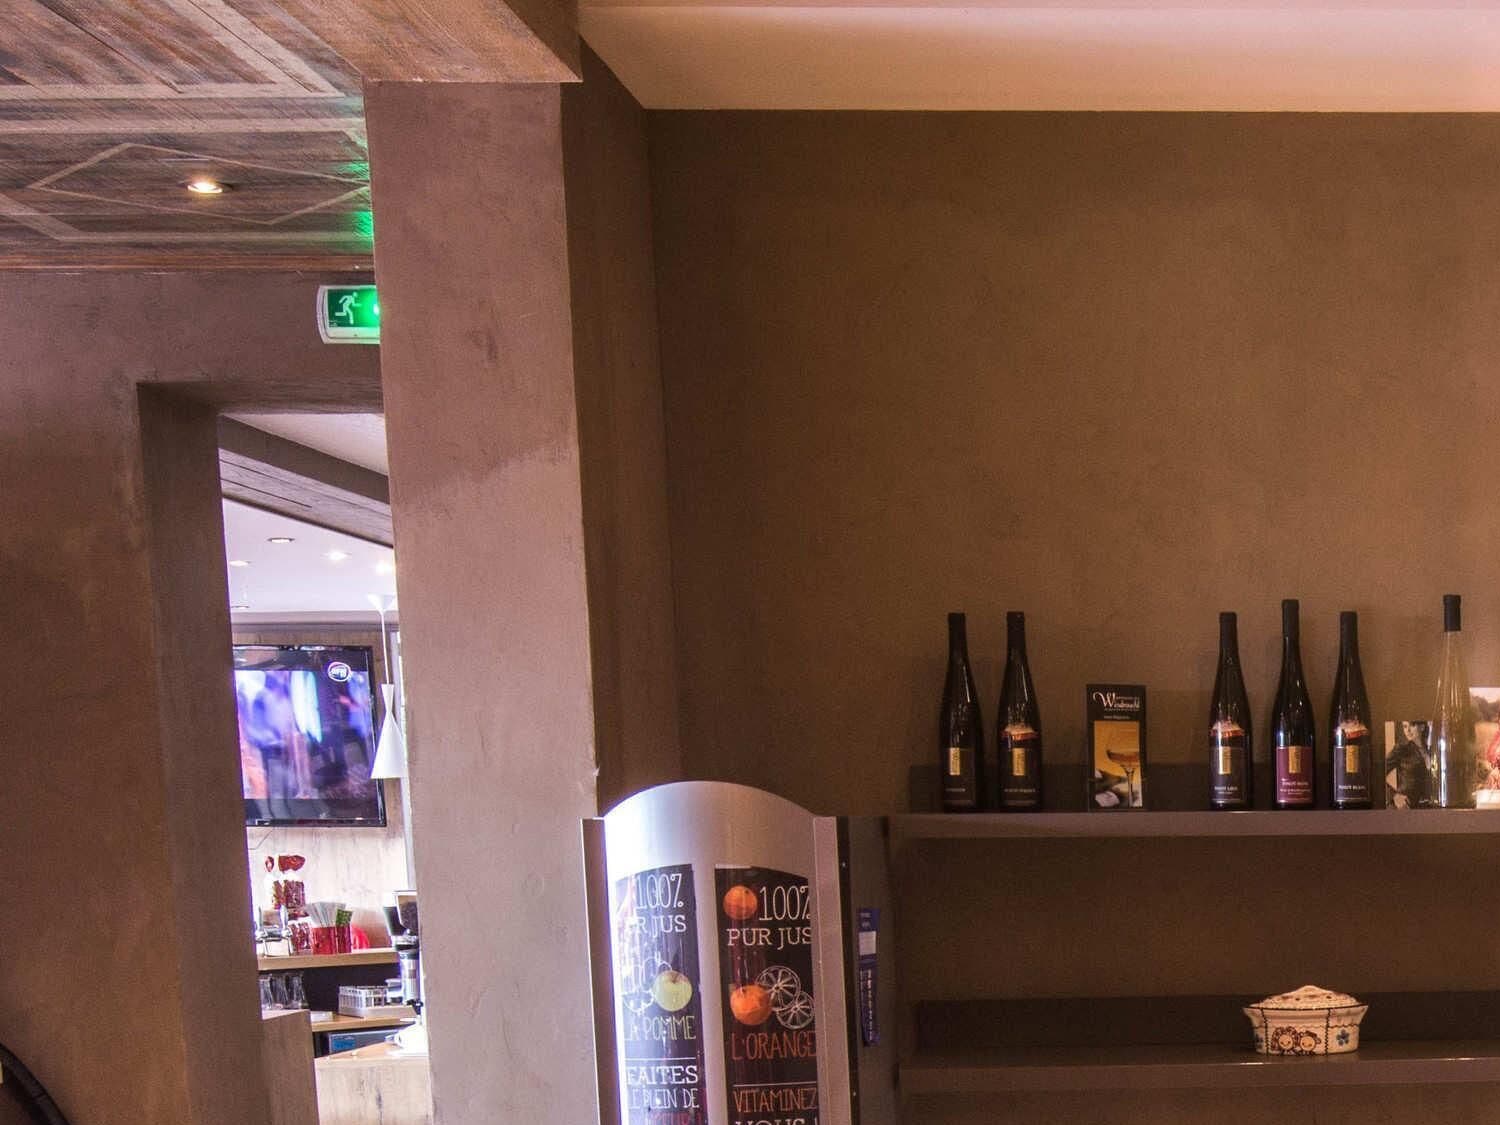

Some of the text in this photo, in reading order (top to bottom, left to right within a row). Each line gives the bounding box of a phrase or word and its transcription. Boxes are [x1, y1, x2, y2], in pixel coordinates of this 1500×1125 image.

[634, 872, 684, 909] 100%
[758, 885, 812, 921] 100%
[651, 914, 687, 938] JUS
[726, 926, 813, 950] PUR JUS
[731, 1030, 817, 1061] L'ORANGE
[626, 1064, 699, 1085] FAITES
[683, 1087, 700, 1109] DE
[733, 1087, 818, 1113] VITAMINEZ
